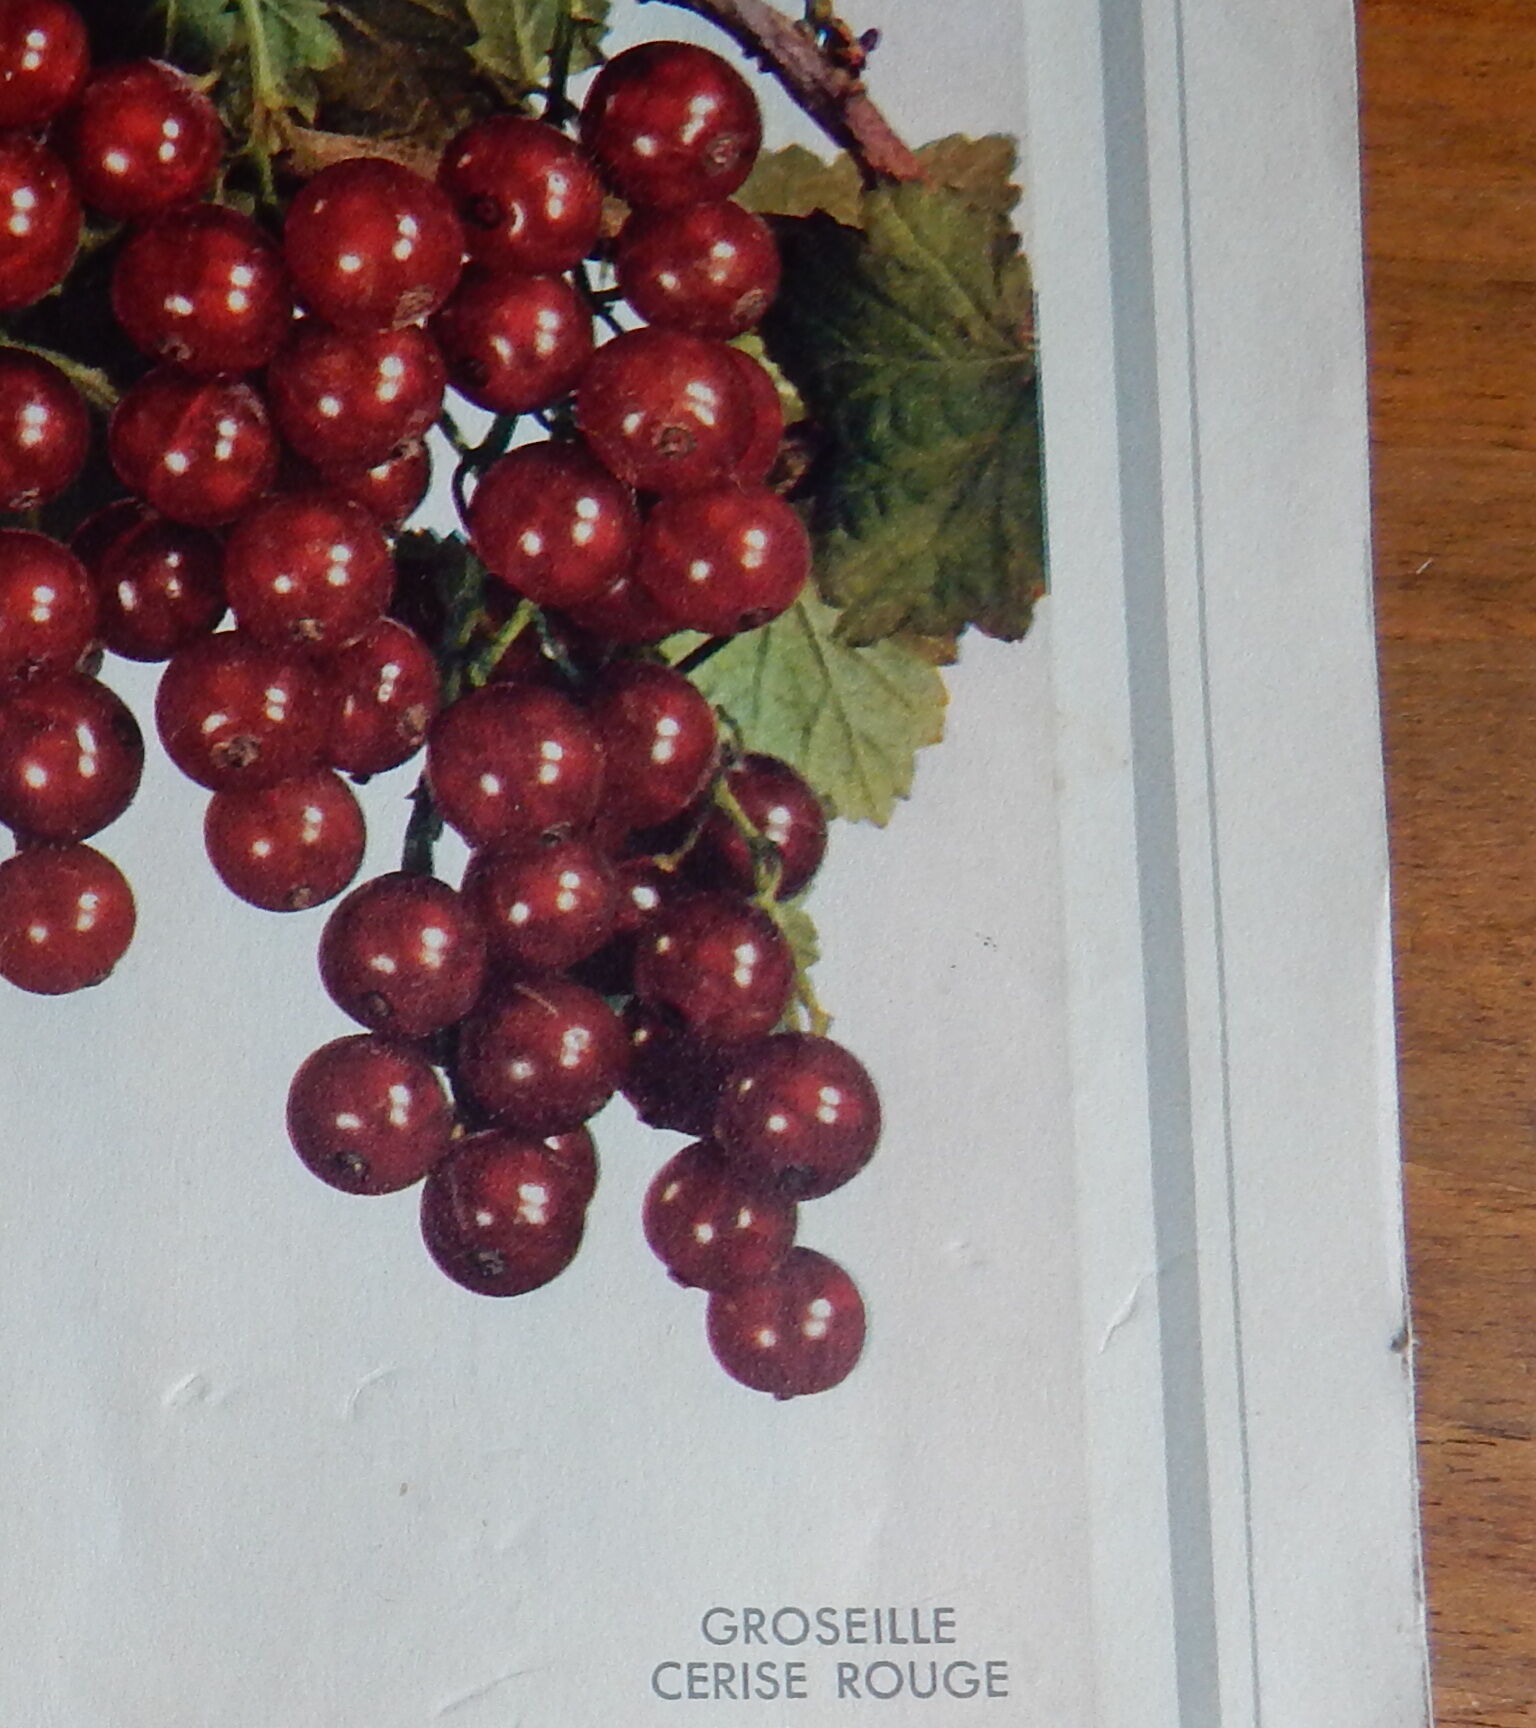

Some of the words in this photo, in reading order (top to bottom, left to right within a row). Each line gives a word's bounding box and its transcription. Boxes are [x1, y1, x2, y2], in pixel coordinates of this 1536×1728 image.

[701, 1606, 957, 1646] GROSEILLE
[651, 1661, 808, 1701] CERISE
[836, 1660, 1009, 1700] ROUGE
